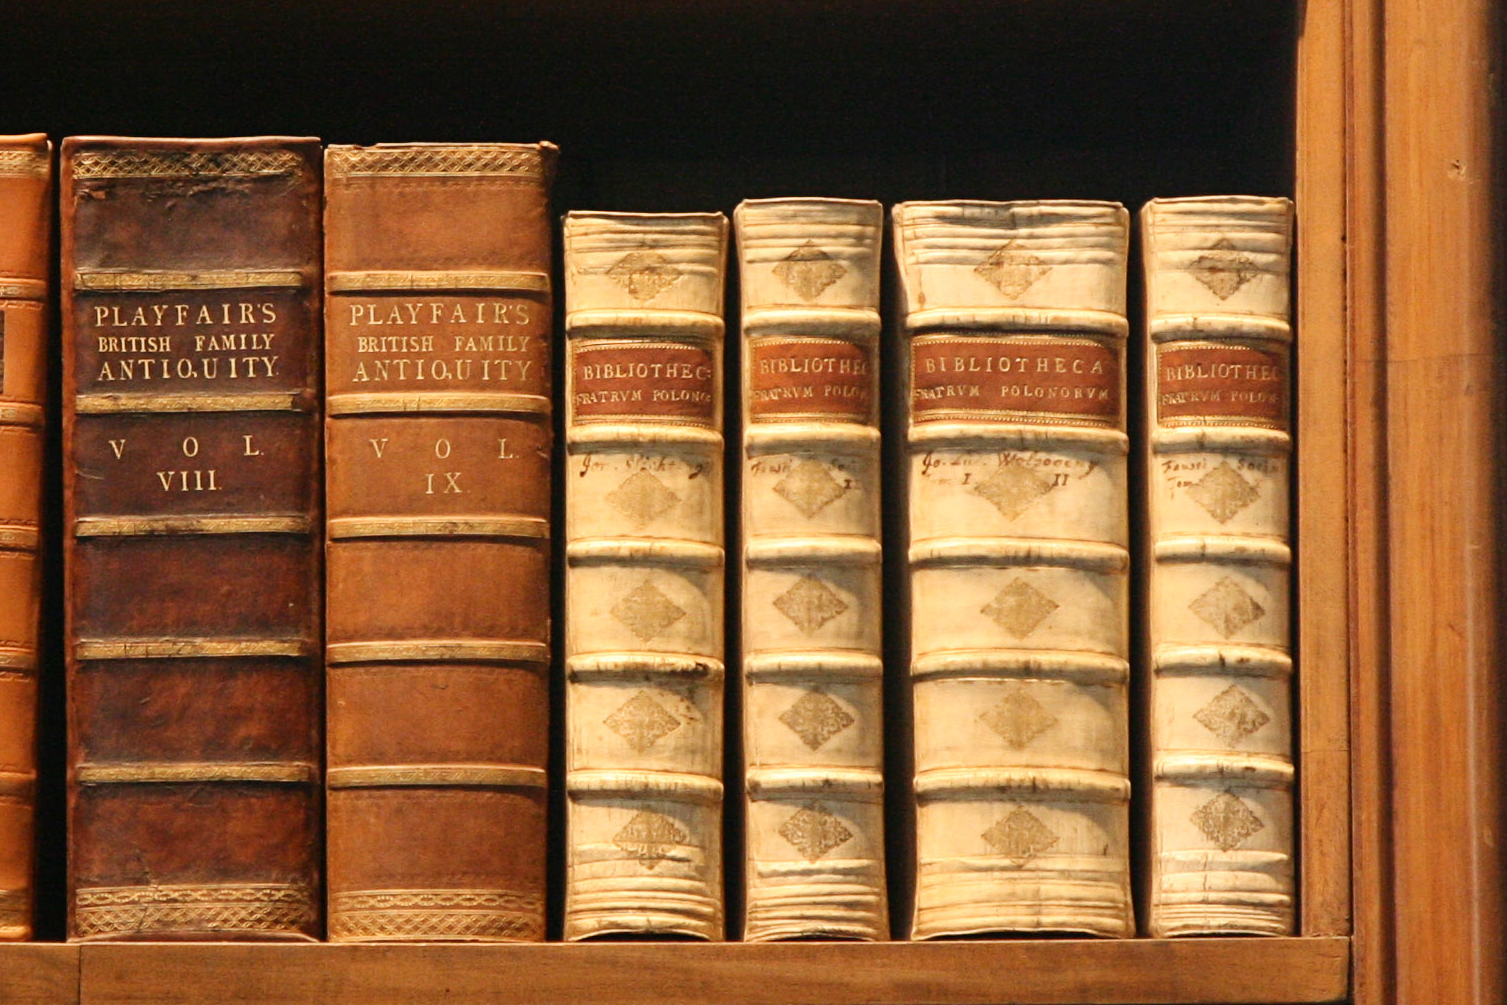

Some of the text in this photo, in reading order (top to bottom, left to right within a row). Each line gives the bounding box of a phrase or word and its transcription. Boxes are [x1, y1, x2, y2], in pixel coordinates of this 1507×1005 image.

[94, 302, 277, 327] PLAYFAIR'S
[349, 302, 530, 326] PLAYFAIR'S
[98, 333, 276, 353] BRITISH FAMILY
[357, 335, 532, 353] BRITISH FAMILY
[926, 356, 1104, 376] BIBLIOTHECA
[1000, 384, 1110, 402] POLONORVM
